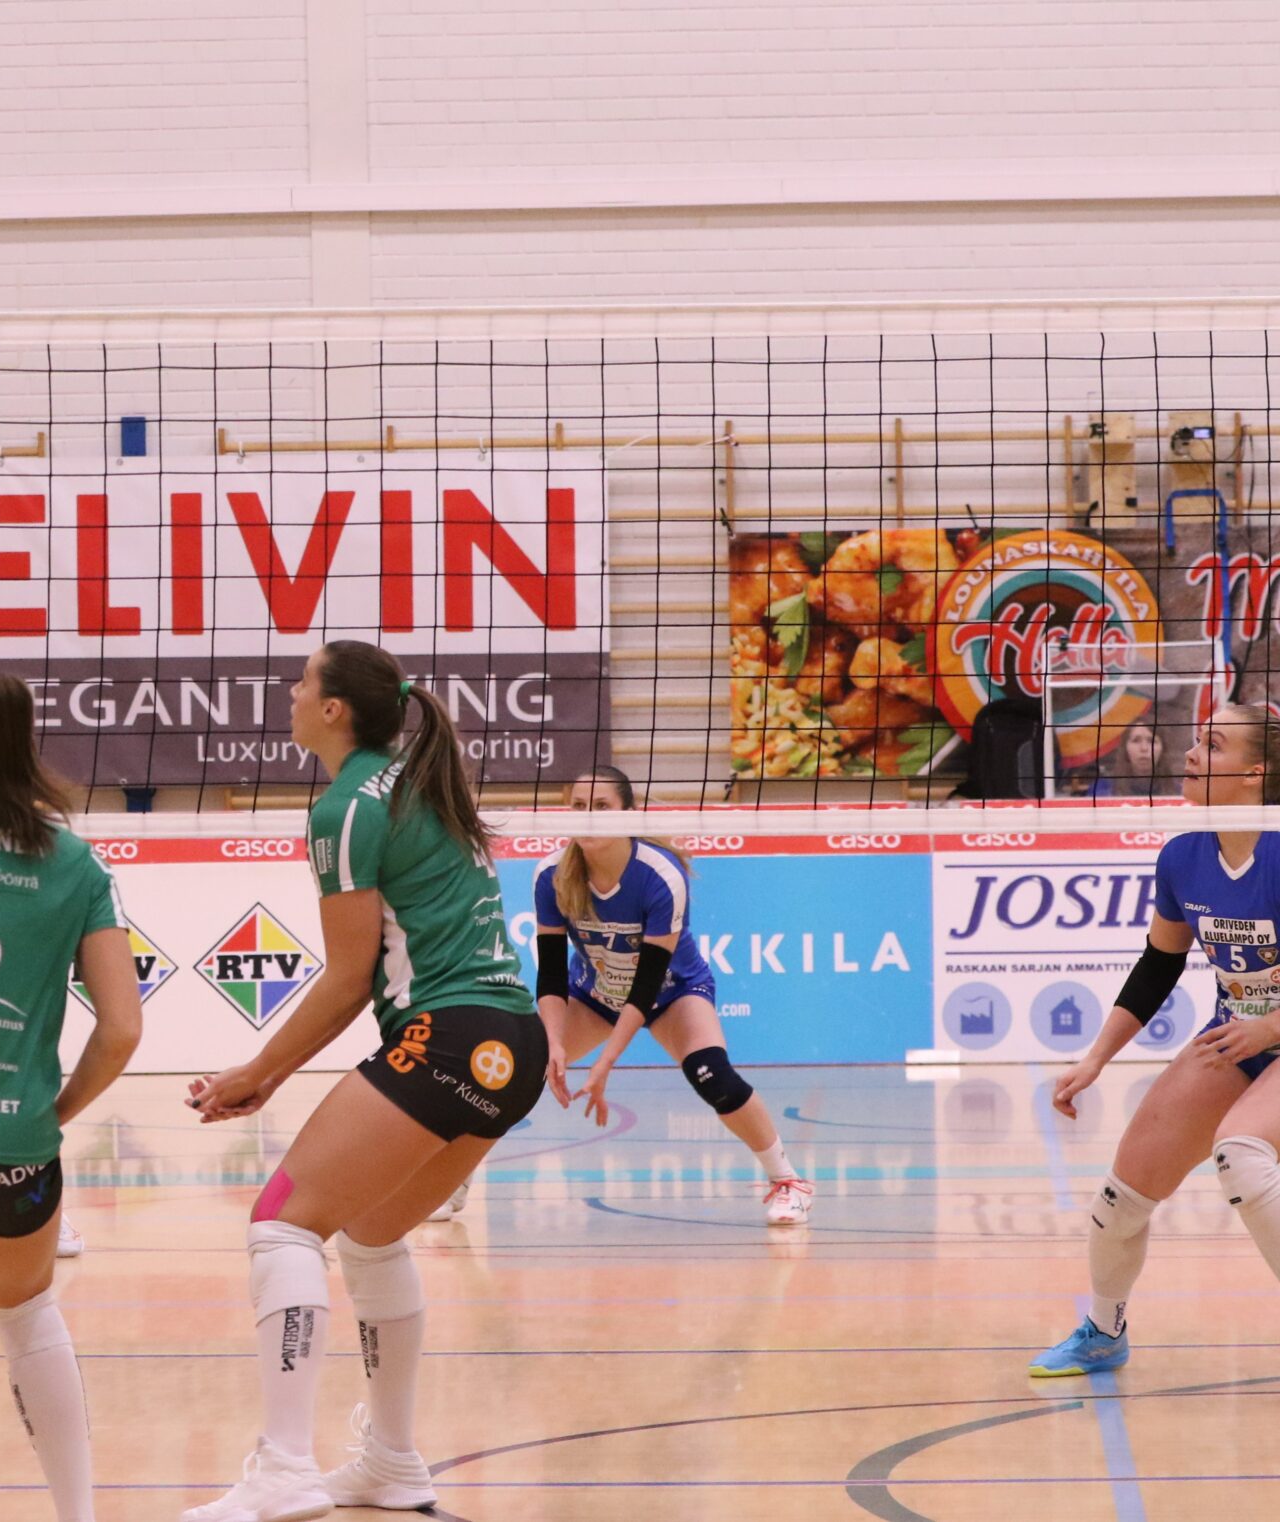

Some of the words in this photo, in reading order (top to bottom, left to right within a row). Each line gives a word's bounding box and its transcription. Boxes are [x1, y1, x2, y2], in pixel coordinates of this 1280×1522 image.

[946, 540, 1151, 622] LOUNASKAHVILA
[197, 735, 310, 770] Luxury
[221, 838, 294, 857] casco
[513, 836, 570, 853] casc
[826, 832, 901, 849] casco
[94, 842, 138, 859] sco
[1214, 918, 1256, 931] ORIVEDEN
[602, 932, 616, 949] 7
[1204, 930, 1255, 944] ALUELÄMPÖ
[1257, 934, 1271, 944] OY
[216, 953, 302, 980] RTV
[1230, 945, 1247, 972] 5
[946, 964, 1007, 974] RASKAAN
[1011, 964, 1062, 973] SARJAN
[1066, 963, 1131, 973] AMMATTIT
[718, 1002, 751, 1018] .com
[281, 1307, 300, 1358] INTERSPO
